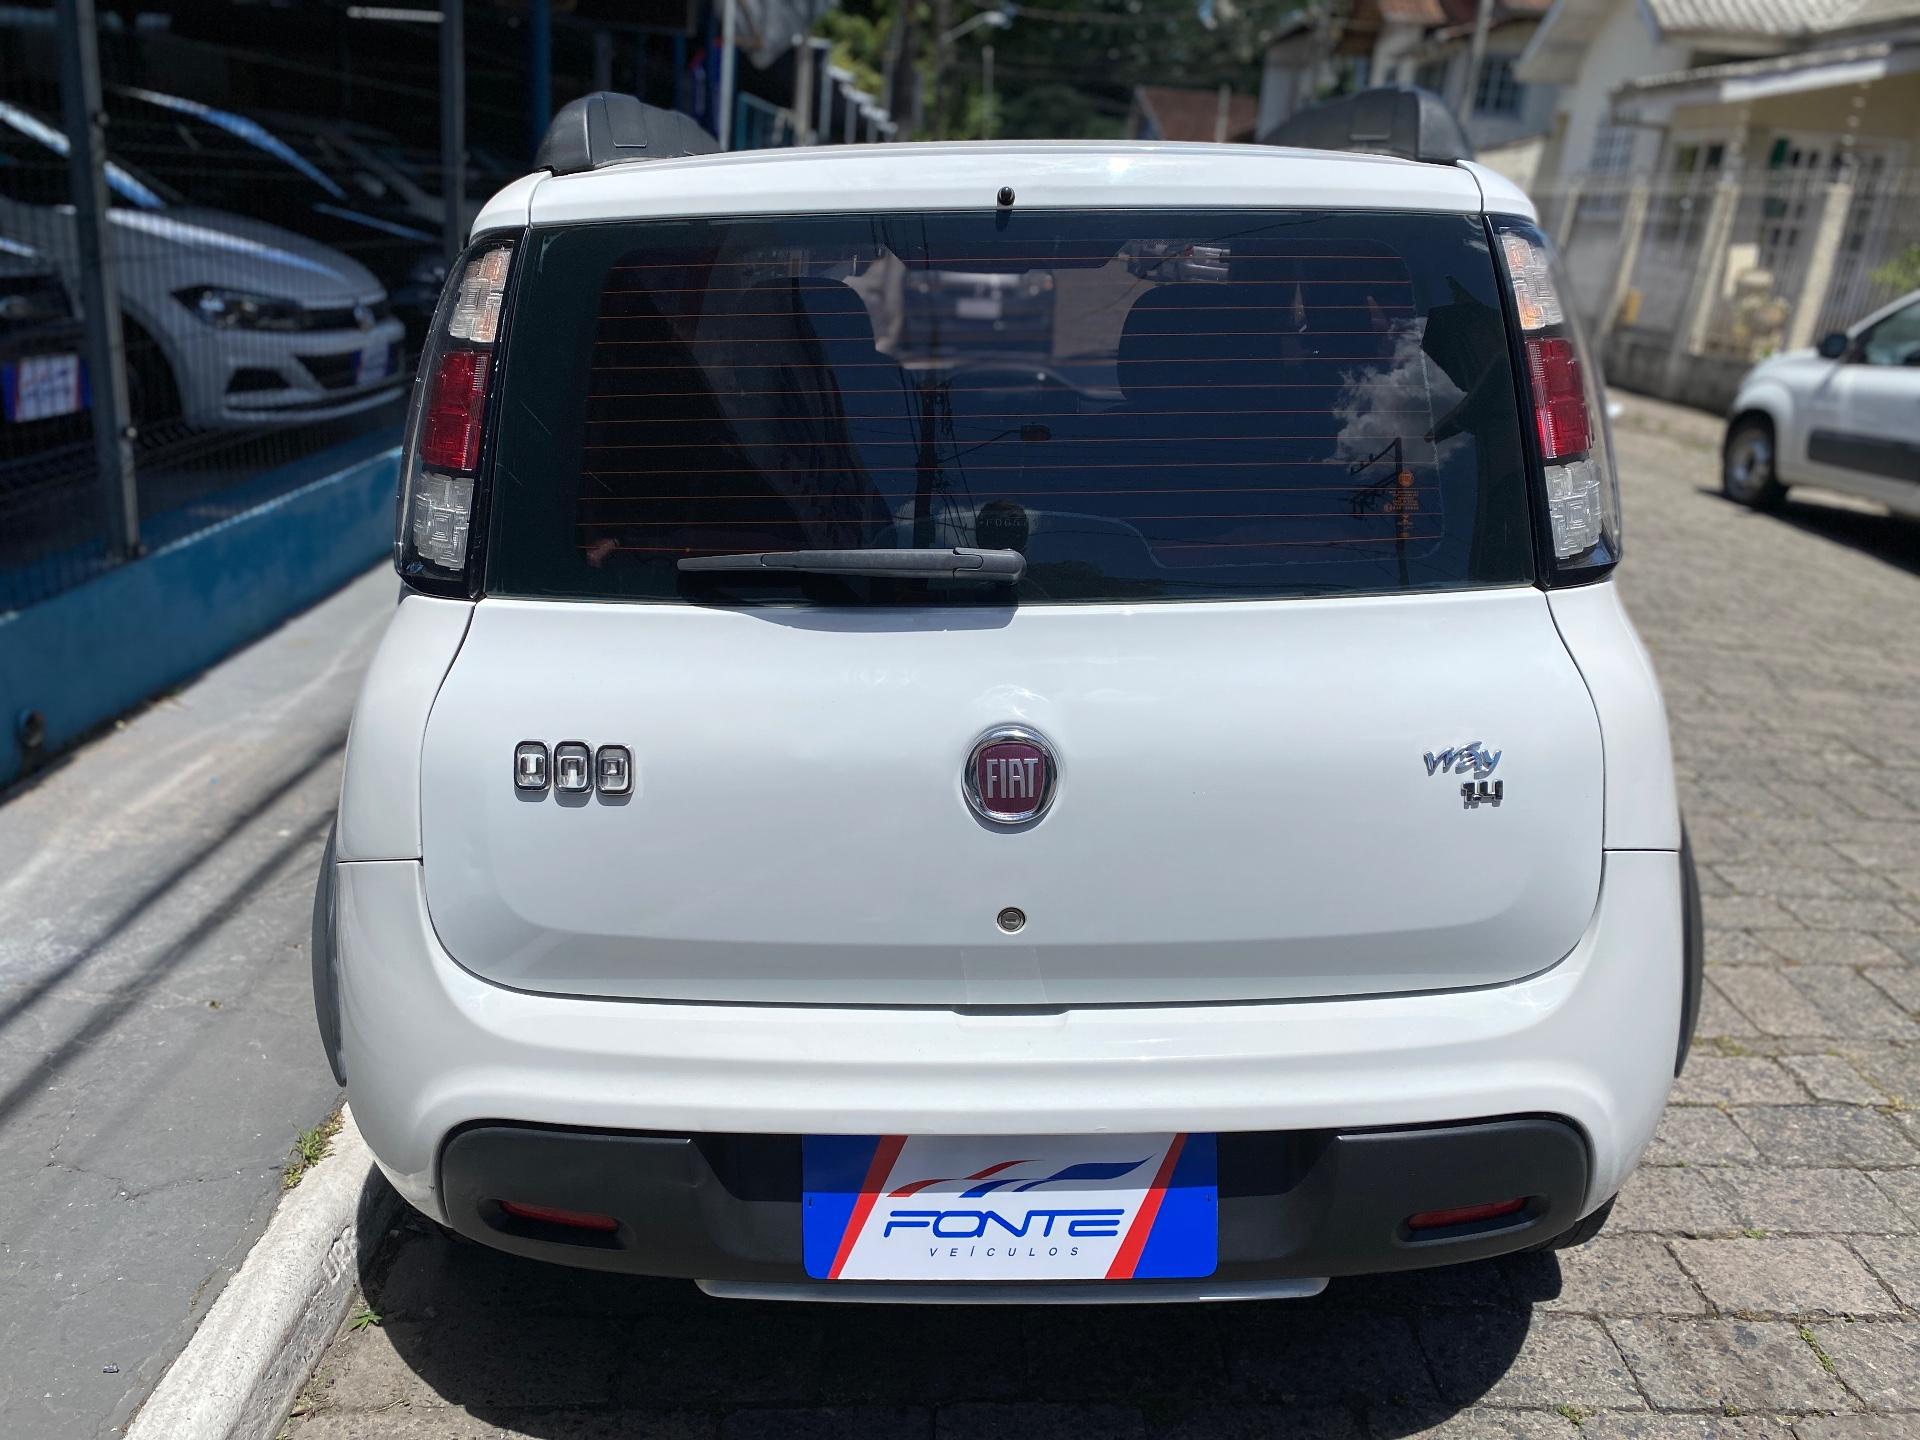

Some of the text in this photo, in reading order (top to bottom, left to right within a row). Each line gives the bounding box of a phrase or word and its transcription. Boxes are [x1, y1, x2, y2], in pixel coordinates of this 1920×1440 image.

[986, 758, 1039, 798] FIAT
[883, 1208, 1125, 1238] FONTE
[929, 1246, 1079, 1257] VEÍCULOS
